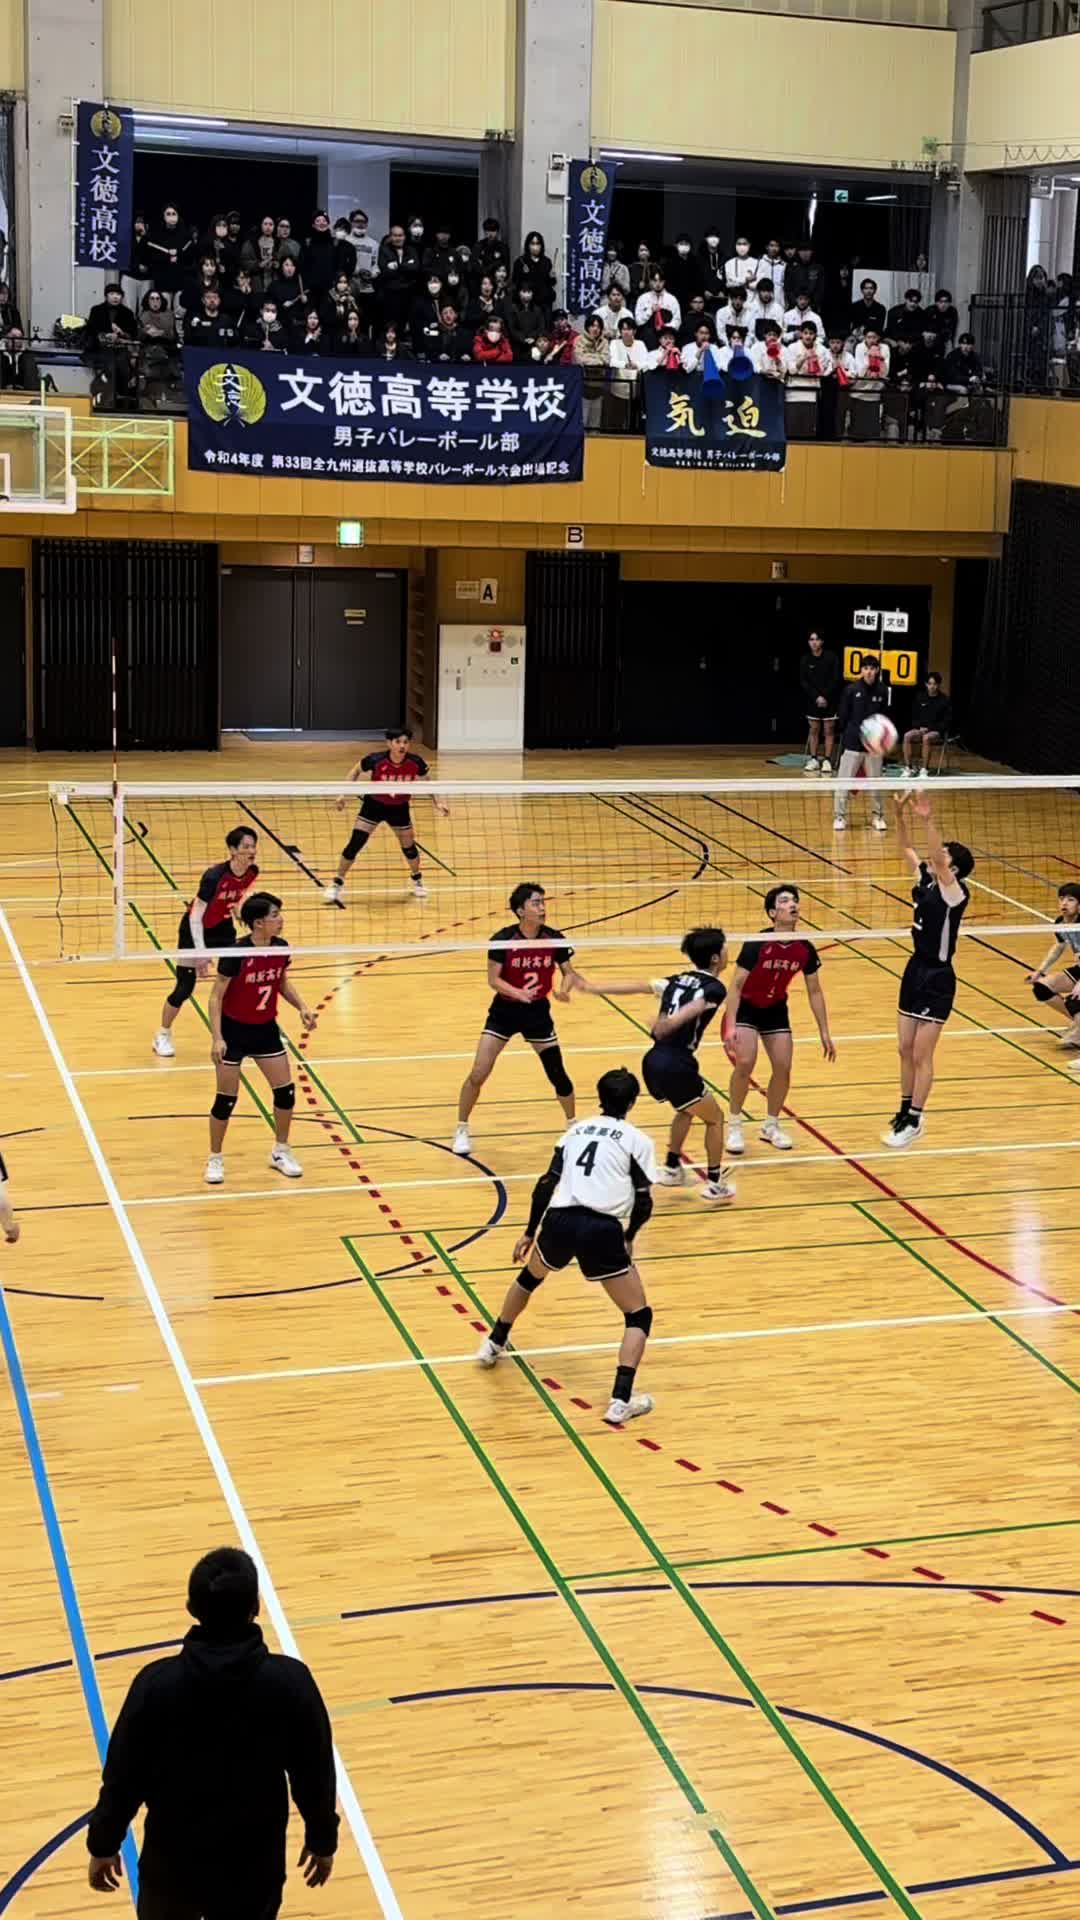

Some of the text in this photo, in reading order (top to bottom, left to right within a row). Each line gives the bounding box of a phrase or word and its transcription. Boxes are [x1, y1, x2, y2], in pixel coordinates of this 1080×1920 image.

[89, 144, 121, 263] 文徳高校
[578, 199, 605, 309] 文徳高校
[277, 367, 567, 423] 文徳高等学校
[665, 391, 767, 438] 気迫
[333, 425, 520, 453] 男子バレーボール部
[204, 449, 264, 468] 令和4年度
[567, 526, 583, 544] B
[482, 583, 494, 601] A
[850, 650, 911, 679] 0 0
[522, 971, 545, 996] 2
[255, 984, 273, 1012] 7
[575, 1140, 600, 1177] 4
